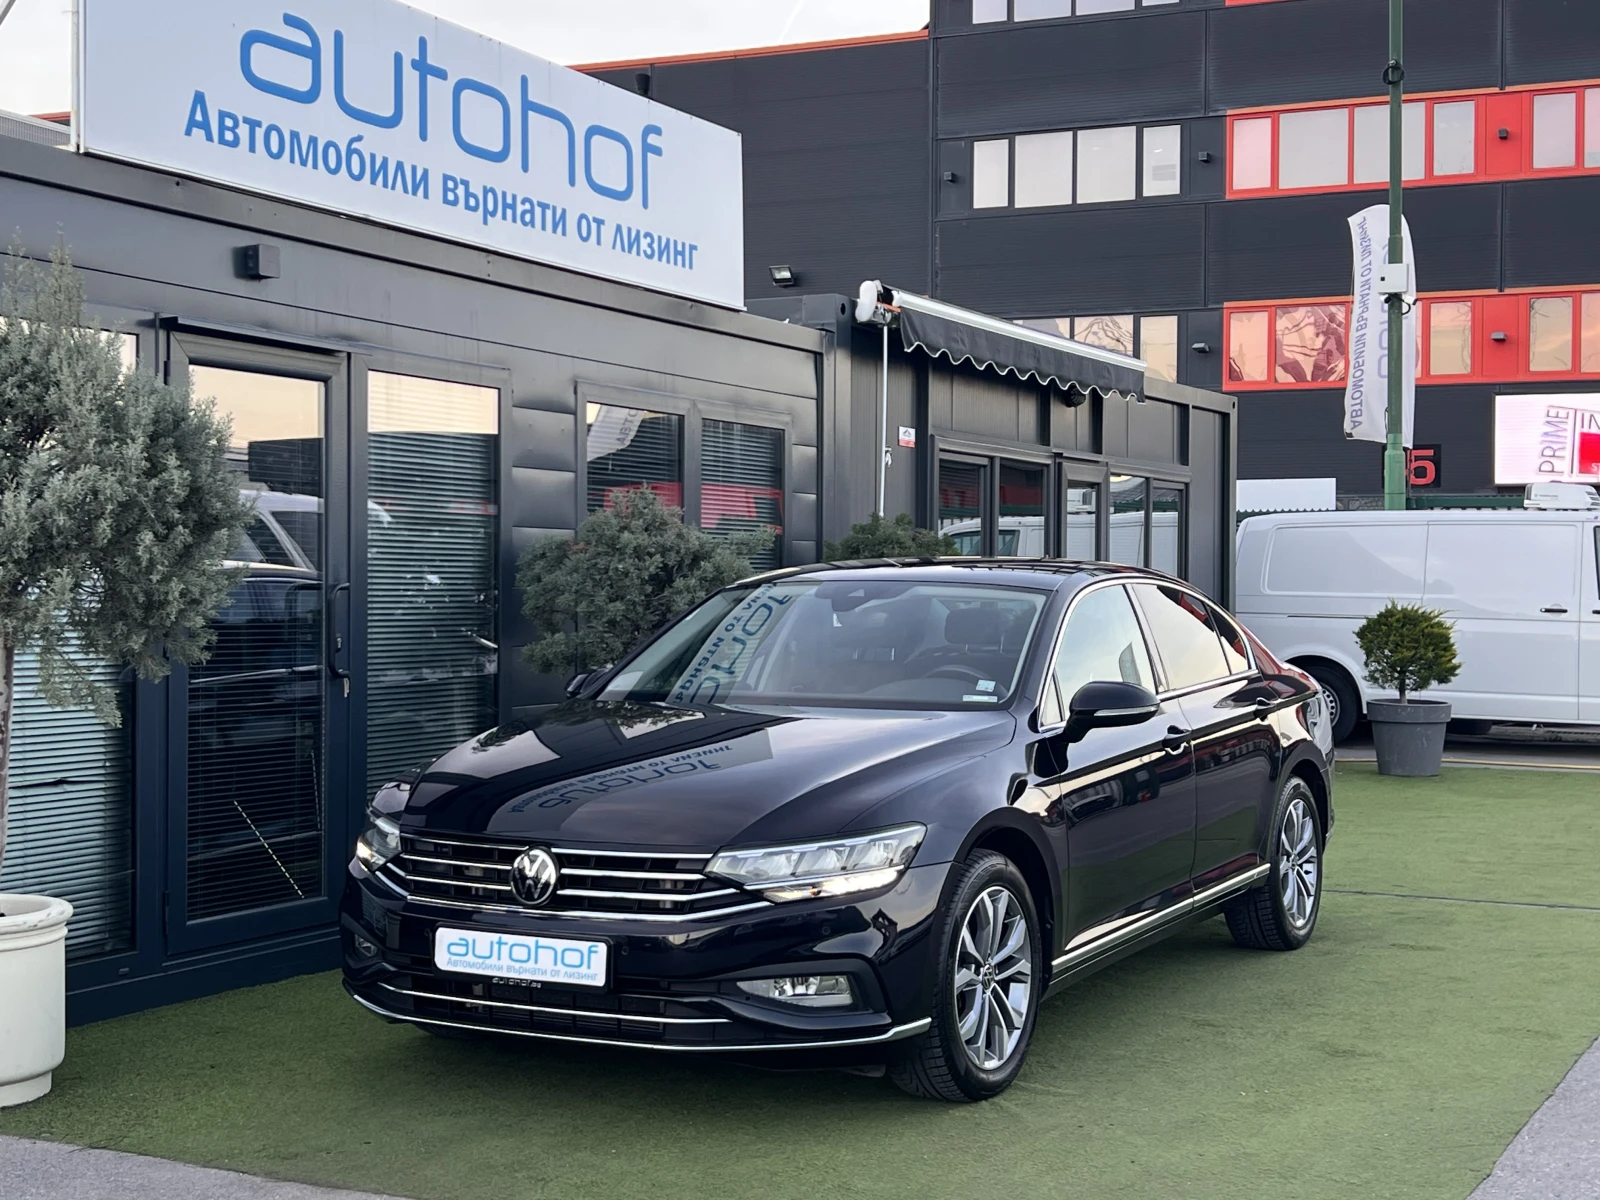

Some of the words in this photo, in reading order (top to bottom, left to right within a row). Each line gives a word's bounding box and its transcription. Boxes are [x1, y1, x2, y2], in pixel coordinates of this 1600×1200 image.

[240, 12, 663, 211] autohof
[184, 89, 429, 200] Автомобили
[442, 172, 568, 238] върнати
[576, 212, 606, 247] от
[612, 223, 699, 271] лизинг
[1538, 408, 1570, 474] PRIME
[446, 956, 504, 973] Автомобили
[506, 965, 547, 977] върнати
[550, 970, 561, 978] от
[563, 970, 598, 982] лизинг
[447, 935, 599, 970] autohof
